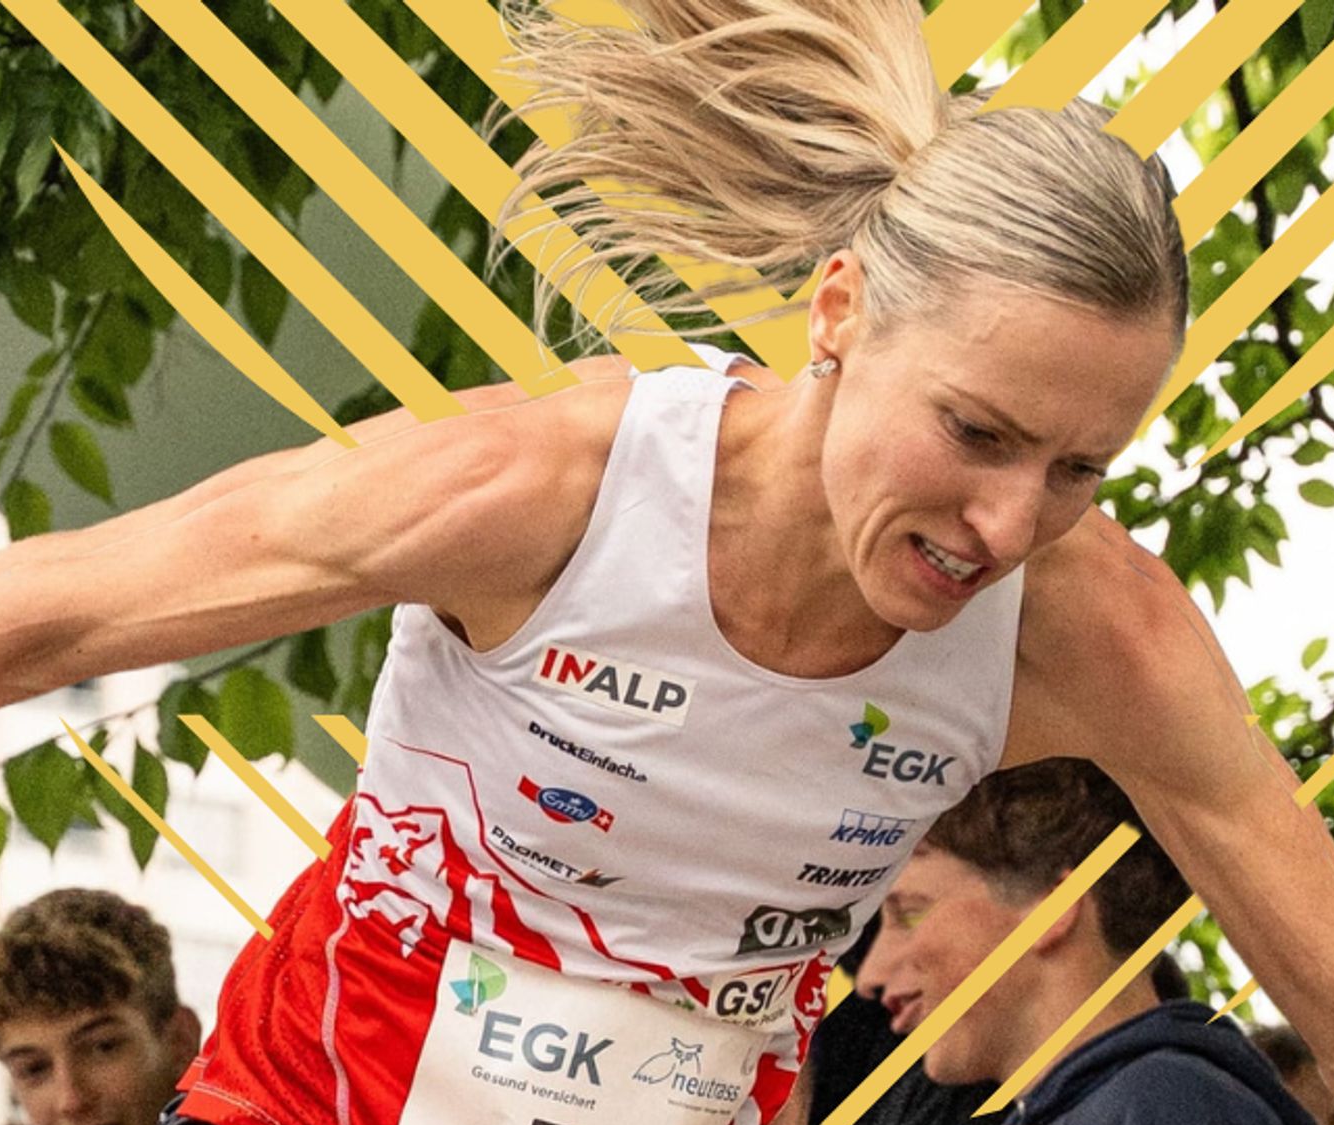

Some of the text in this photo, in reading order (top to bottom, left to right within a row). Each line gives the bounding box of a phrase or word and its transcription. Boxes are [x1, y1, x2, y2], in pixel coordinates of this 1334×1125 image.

[540, 648, 687, 713] INALP
[862, 742, 957, 785] EGK
[542, 791, 595, 819] Emmi
[491, 825, 579, 878] PROMET
[829, 824, 906, 847] KPMG
[478, 1010, 614, 1086] EGK
[471, 1065, 597, 1110] Gesund versichert
[672, 1072, 741, 1102] neutrass
